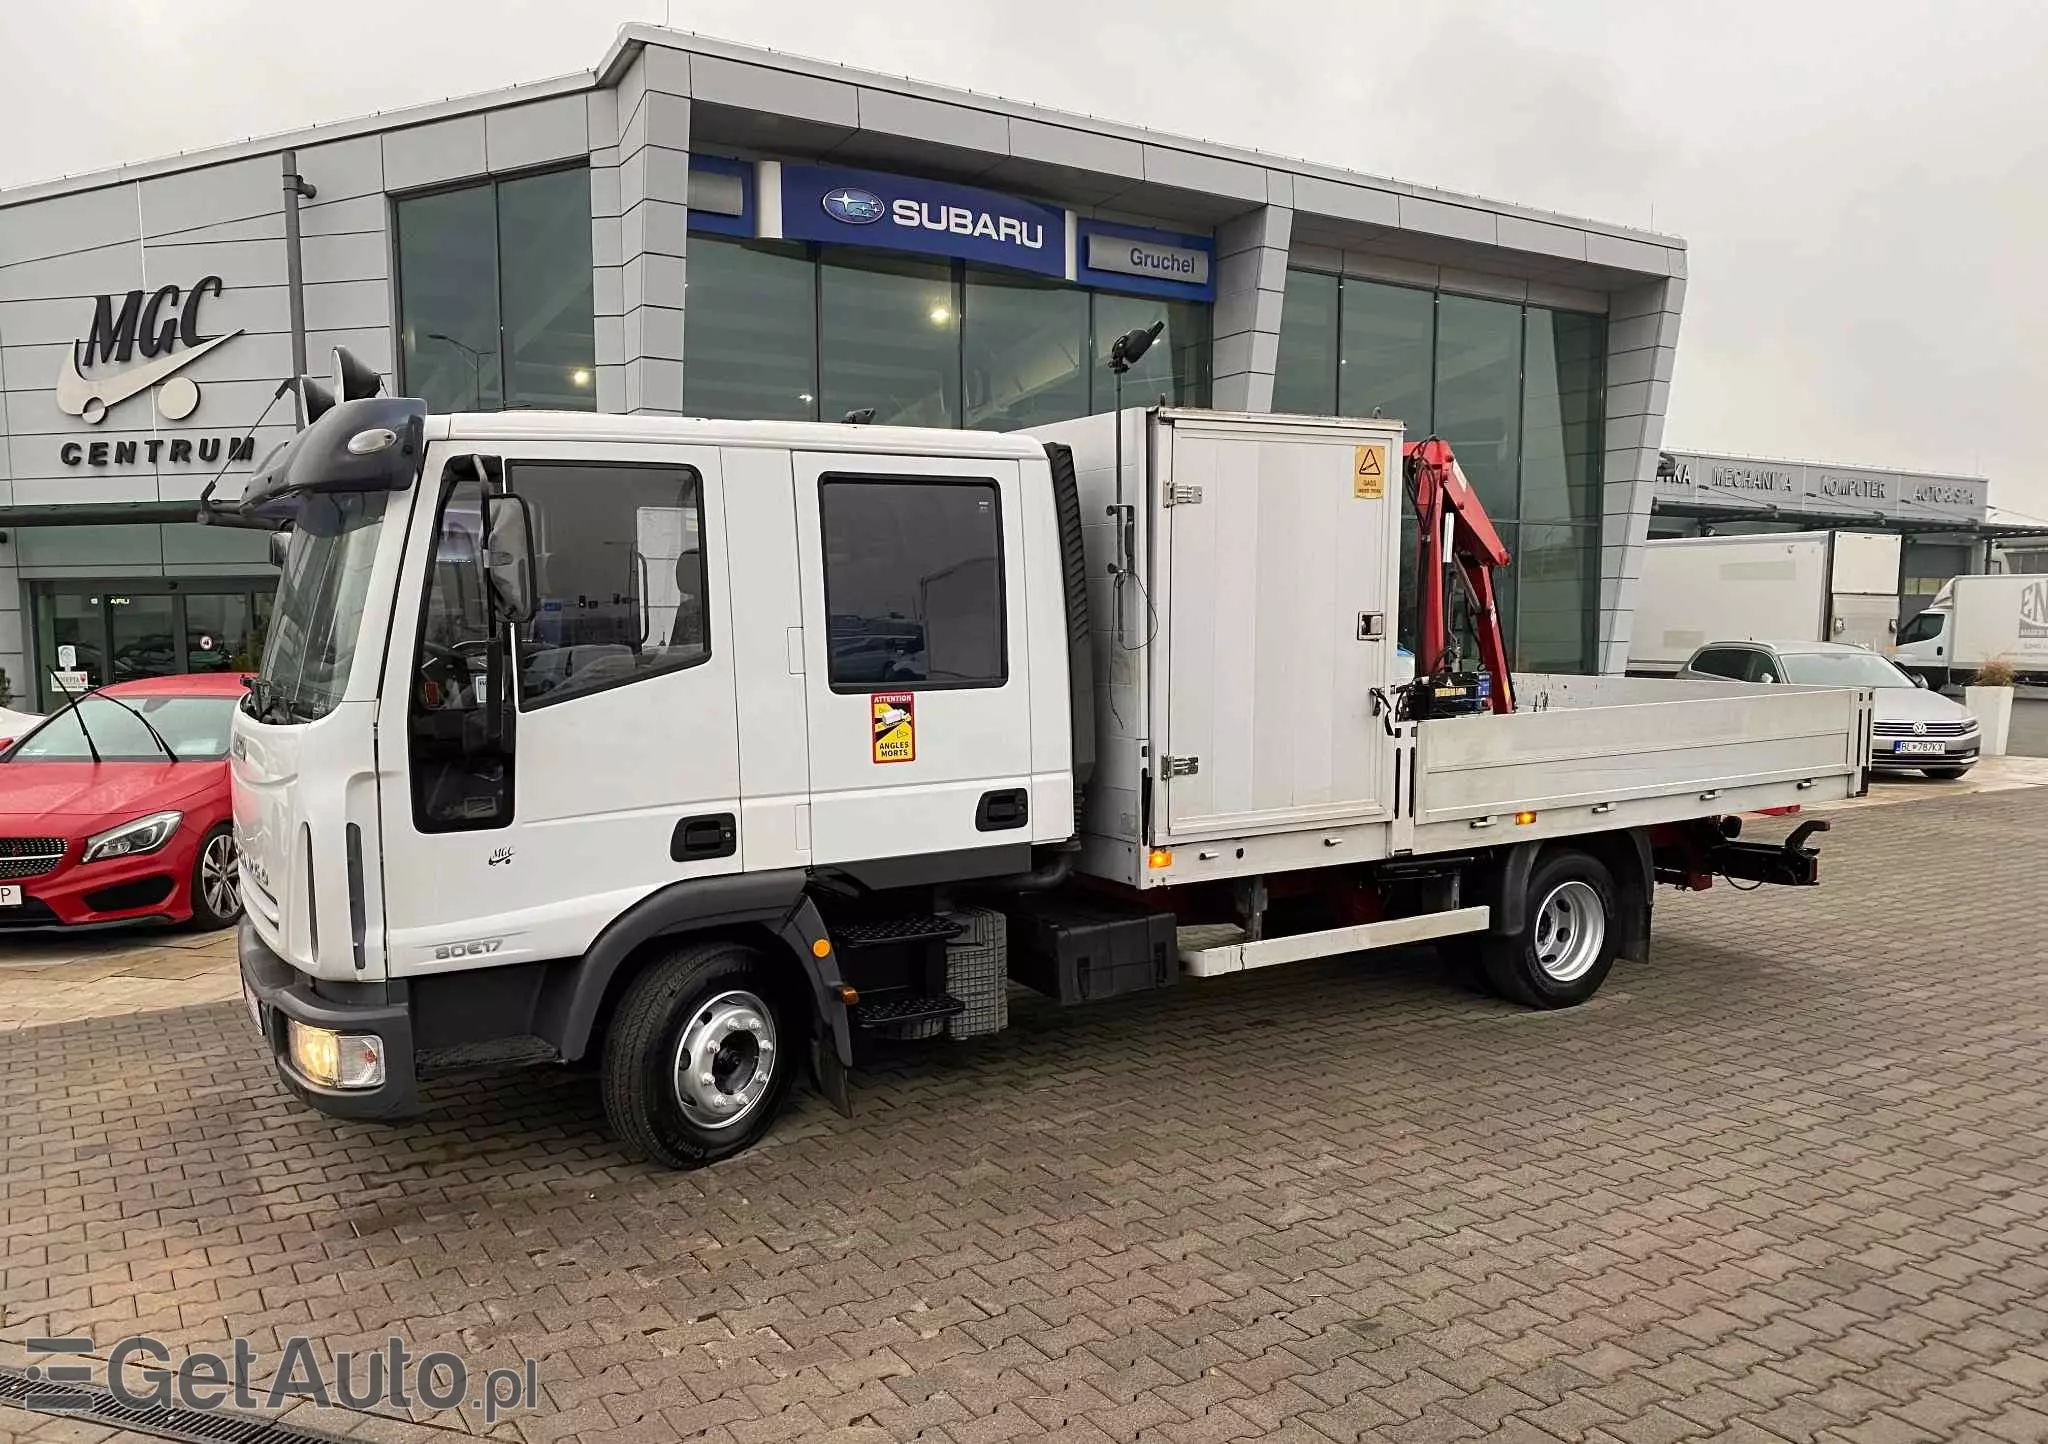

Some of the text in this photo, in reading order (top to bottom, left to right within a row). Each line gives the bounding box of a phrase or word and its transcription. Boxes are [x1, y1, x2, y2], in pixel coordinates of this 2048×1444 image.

[893, 199, 1044, 249] SUBARU
[1130, 247, 1195, 275] Gruchel
[82, 275, 223, 367] MGC
[61, 437, 256, 467] CENTRUM
[1712, 465, 1793, 492] MECHANIA
[1821, 475, 1887, 499] KOMPUTER
[874, 694, 912, 703] ATTENTION
[880, 741, 909, 750] ANGLES
[881, 749, 908, 757] MORTS
[434, 940, 504, 960] 80E17
